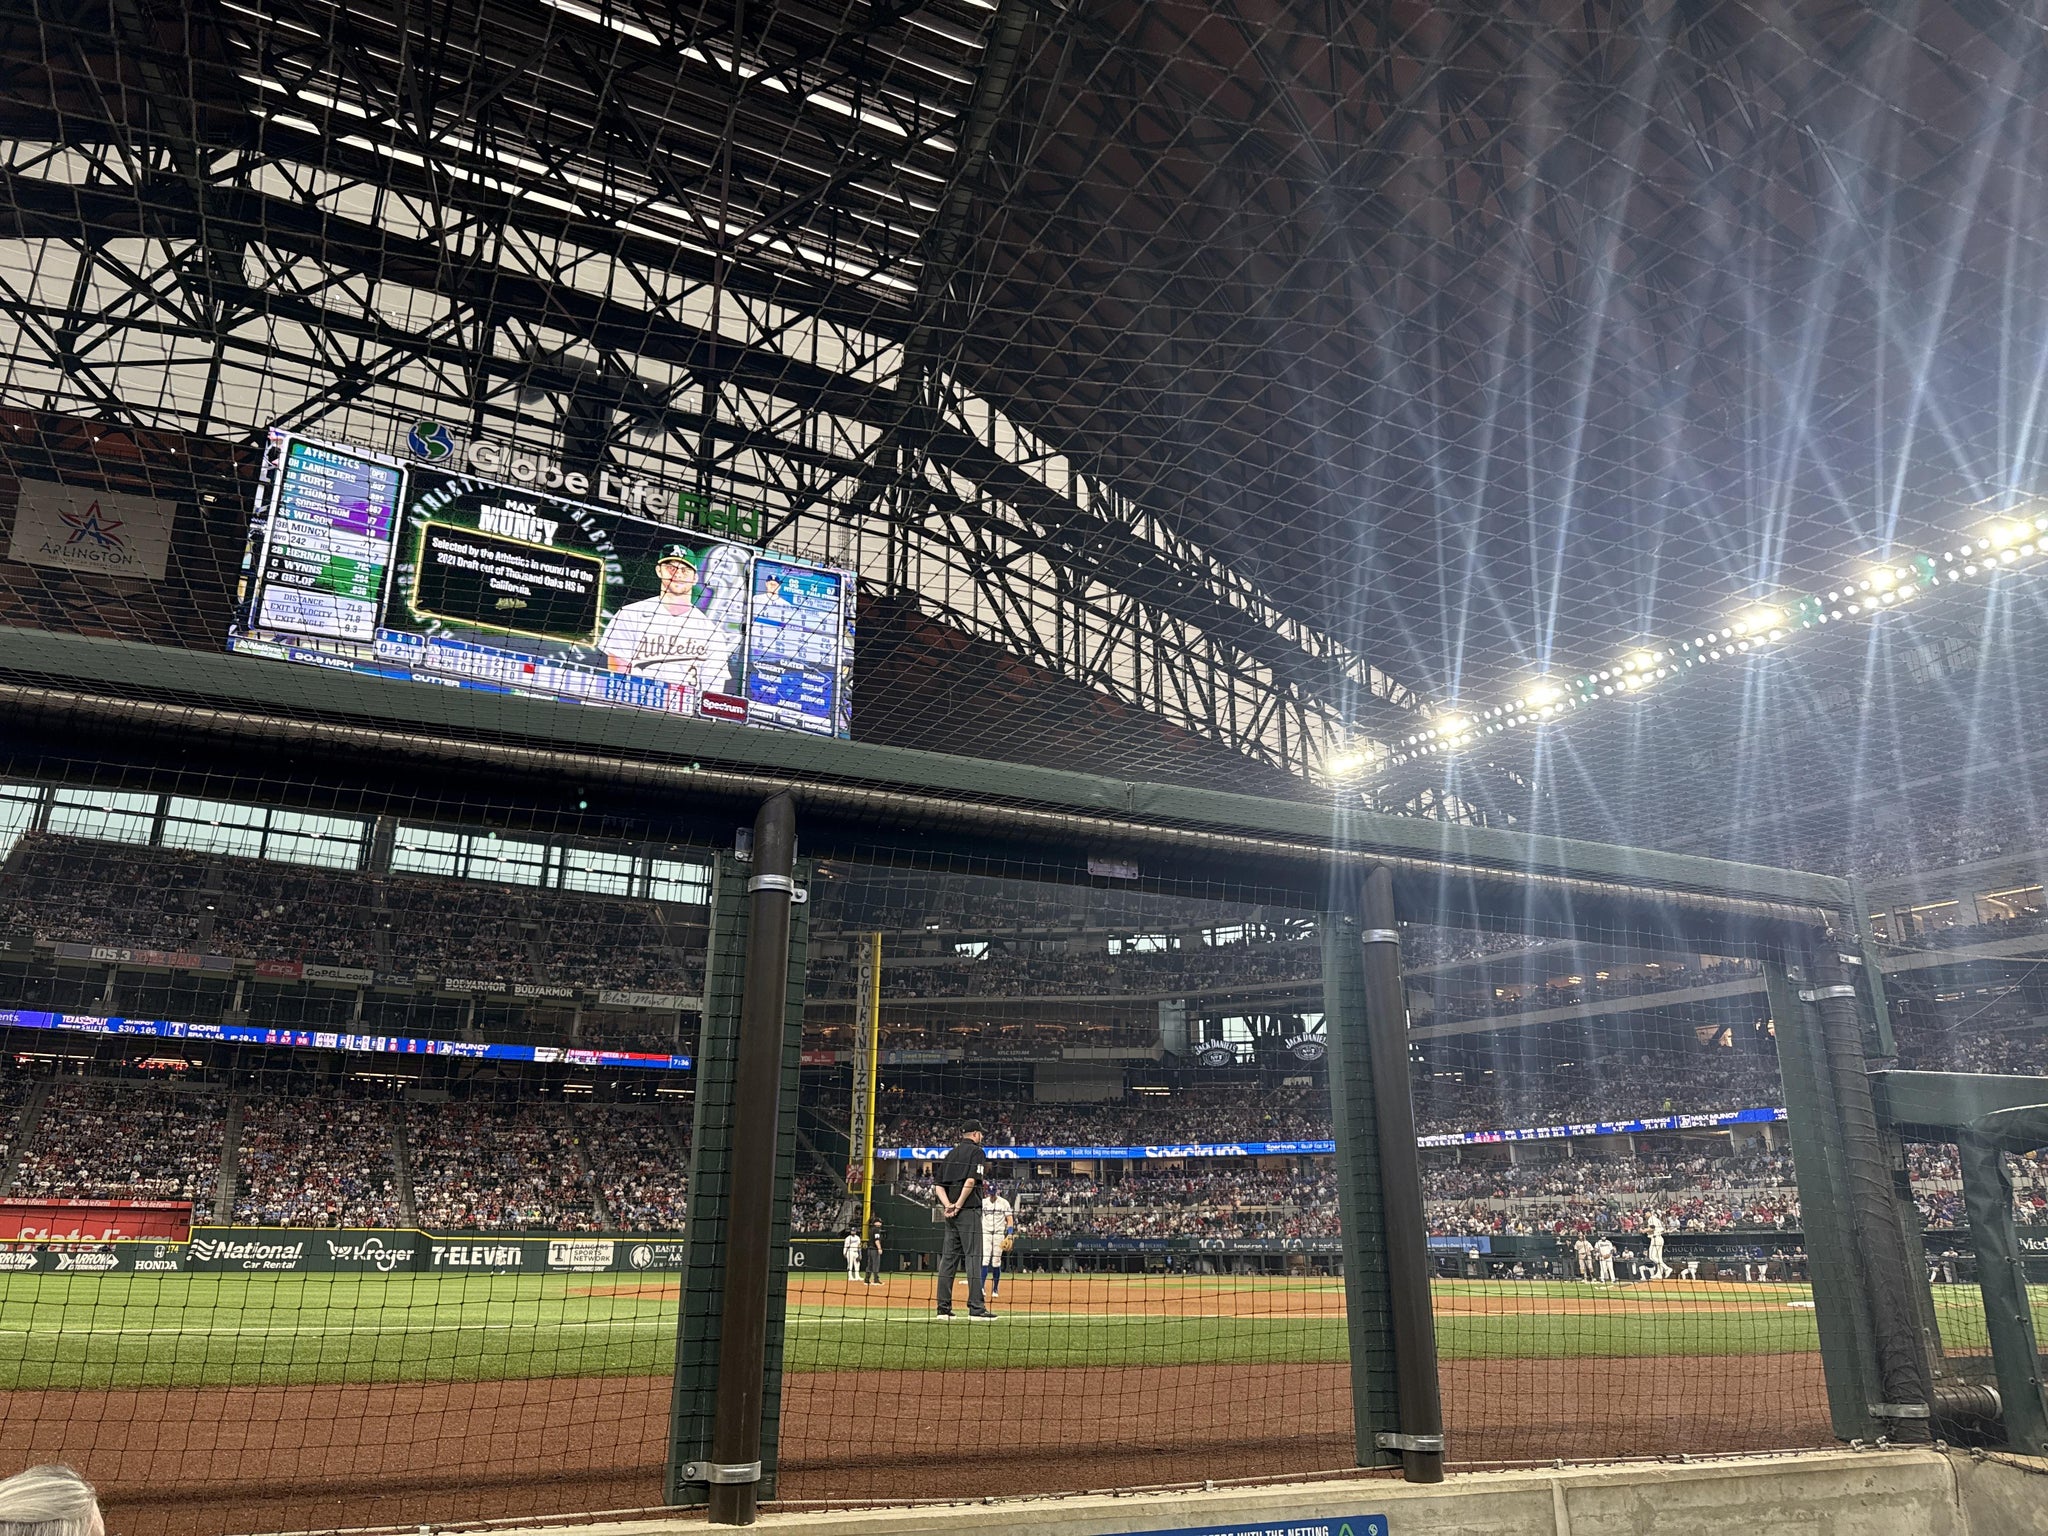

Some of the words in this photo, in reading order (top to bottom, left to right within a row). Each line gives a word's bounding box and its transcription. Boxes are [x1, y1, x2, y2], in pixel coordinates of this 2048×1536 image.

[304, 447, 360, 469] ATHLETICS
[302, 462, 356, 482] LANGELIERS
[300, 474, 334, 489] KURTZ
[298, 486, 340, 503] THOMAS
[468, 440, 590, 495] Globe
[599, 470, 668, 516] Life
[677, 492, 760, 539] Field
[295, 498, 350, 518] SODERSTROM
[506, 499, 537, 515] MAX
[294, 510, 333, 526] WILSON
[479, 504, 558, 545] MUNCY
[291, 523, 327, 537] MUNCY
[40, 542, 133, 565] ARLINGTON
[286, 547, 331, 563] HERNAIZ
[432, 537, 467, 555] Selected
[469, 545, 479, 558] by
[480, 548, 493, 560] the
[495, 551, 530, 568] Athletics
[531, 559, 538, 569] in
[540, 564, 565, 576] round
[570, 568, 581, 579] of
[581, 570, 594, 582] the
[271, 559, 279, 567] C
[284, 560, 322, 574] WYNNS
[437, 553, 456, 565] 2021
[457, 557, 479, 571] Draft
[481, 562, 494, 574] out
[494, 565, 505, 577] of
[505, 567, 543, 585] Thousand
[544, 576, 564, 589] Oaks
[565, 581, 577, 592] HS
[577, 583, 585, 593] in
[267, 571, 279, 580] CF
[281, 572, 315, 586] GELOF
[489, 578, 532, 596] California.
[284, 593, 324, 606] DISTANCE
[270, 603, 291, 612] EXIT
[293, 606, 333, 618] VELOCITY
[297, 617, 325, 628] ANGLE
[380, 643, 388, 653] 0
[395, 646, 402, 655] 2
[325, 657, 354, 669] MPH
[412, 673, 461, 688] CUTTER
[703, 699, 745, 714] Spectrum
[91, 948, 131, 961] 105.3
[134, 952, 164, 964] THE
[445, 978, 507, 992] BODYARMOR
[514, 983, 573, 998] BODYARMOR
[602, 993, 631, 1004] Blue
[633, 995, 669, 1007] Mint
[858, 964, 871, 1049] CHIKIN
[89, 1017, 108, 1025] SPLIT
[118, 1025, 157, 1034] $30,105
[455, 1043, 490, 1051] MUNCY
[1195, 1042, 1211, 1055] JACK
[1285, 1036, 1301, 1049] JACK
[1709, 1112, 1739, 1120] MUNCY
[214, 1241, 303, 1259] National
[354, 1237, 414, 1271] Kroger
[553, 1244, 568, 1261] T
[655, 1245, 673, 1253] EAST
[74, 1253, 111, 1264] ARROW
[135, 1260, 178, 1270] HONDA
[242, 1260, 260, 1269] Car
[262, 1260, 296, 1269] Rental
[1265, 1528, 1284, 1536] THE
[1287, 1526, 1329, 1536] NETTING
